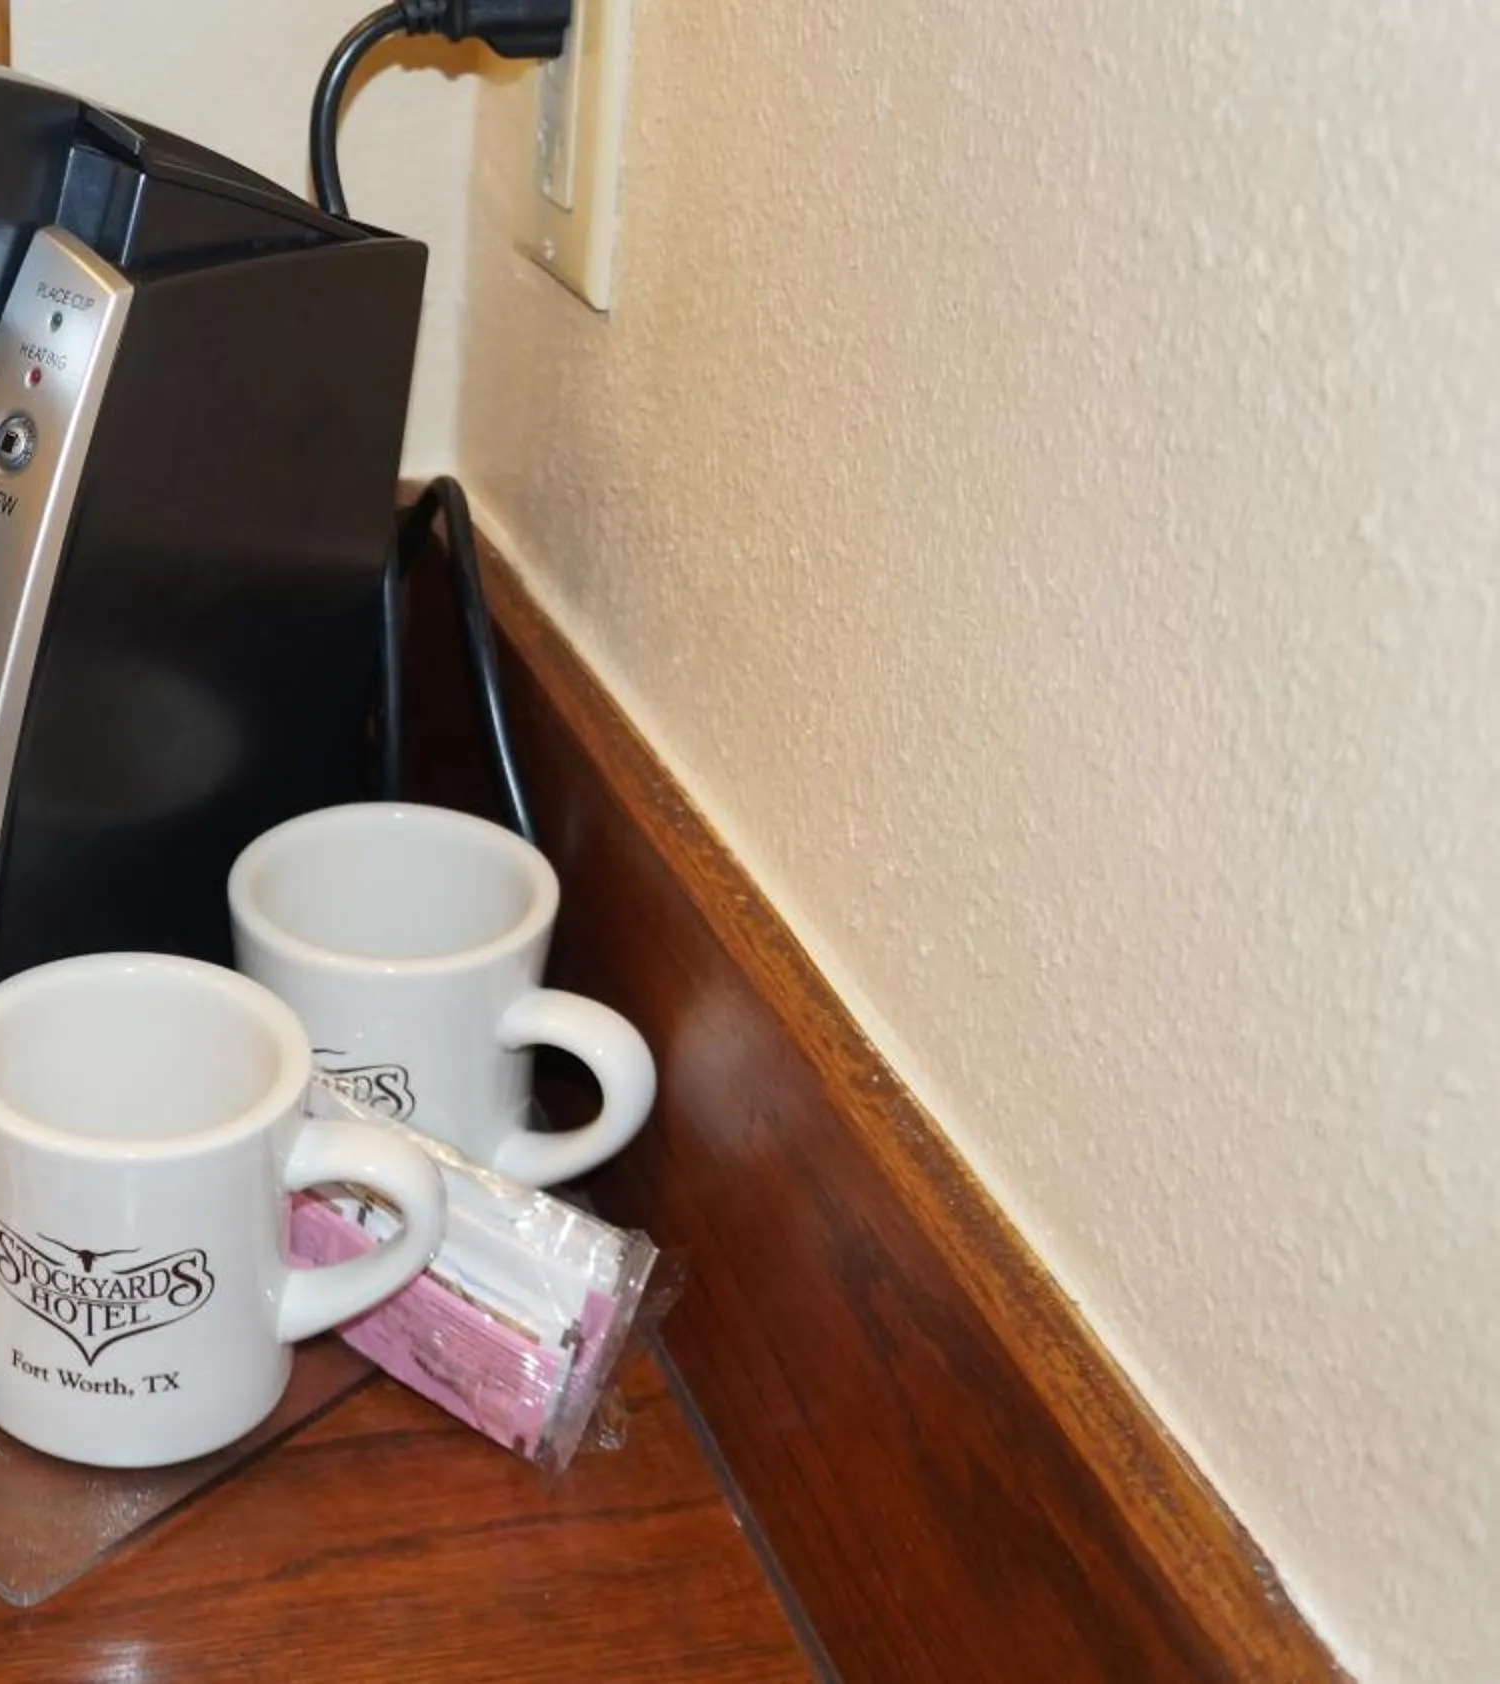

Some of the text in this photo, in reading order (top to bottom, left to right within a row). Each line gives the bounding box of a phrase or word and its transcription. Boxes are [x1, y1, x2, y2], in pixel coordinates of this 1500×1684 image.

[19, 342, 67, 371] HEATING
[31, 1283, 151, 1337] HOTEL
[11, 1349, 181, 1398] Fort Worth, TX
